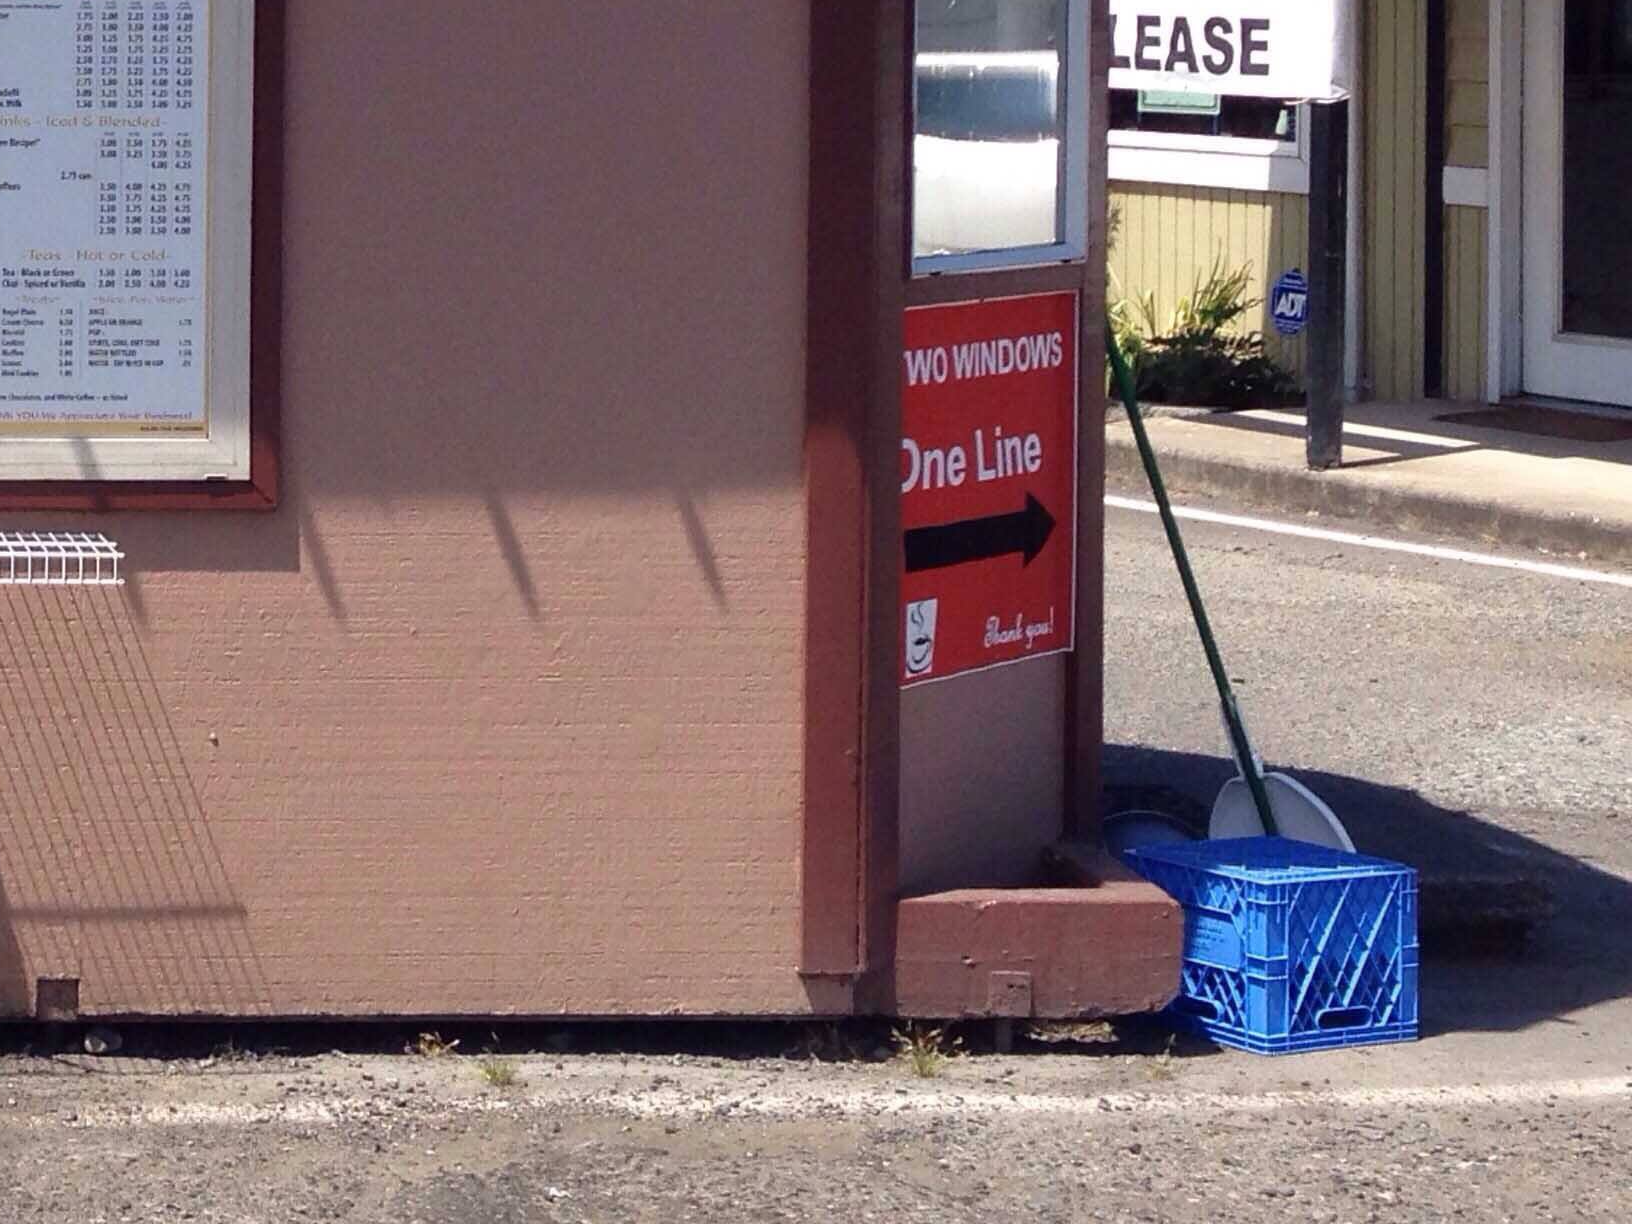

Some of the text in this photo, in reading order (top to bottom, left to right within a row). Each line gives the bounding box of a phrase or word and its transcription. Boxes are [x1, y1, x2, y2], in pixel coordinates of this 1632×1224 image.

[1274, 292, 1308, 318] ADT
[904, 331, 1064, 386] WO WINDOWS
[974, 425, 1042, 481] Line
[983, 605, 1055, 651] Thank you!
